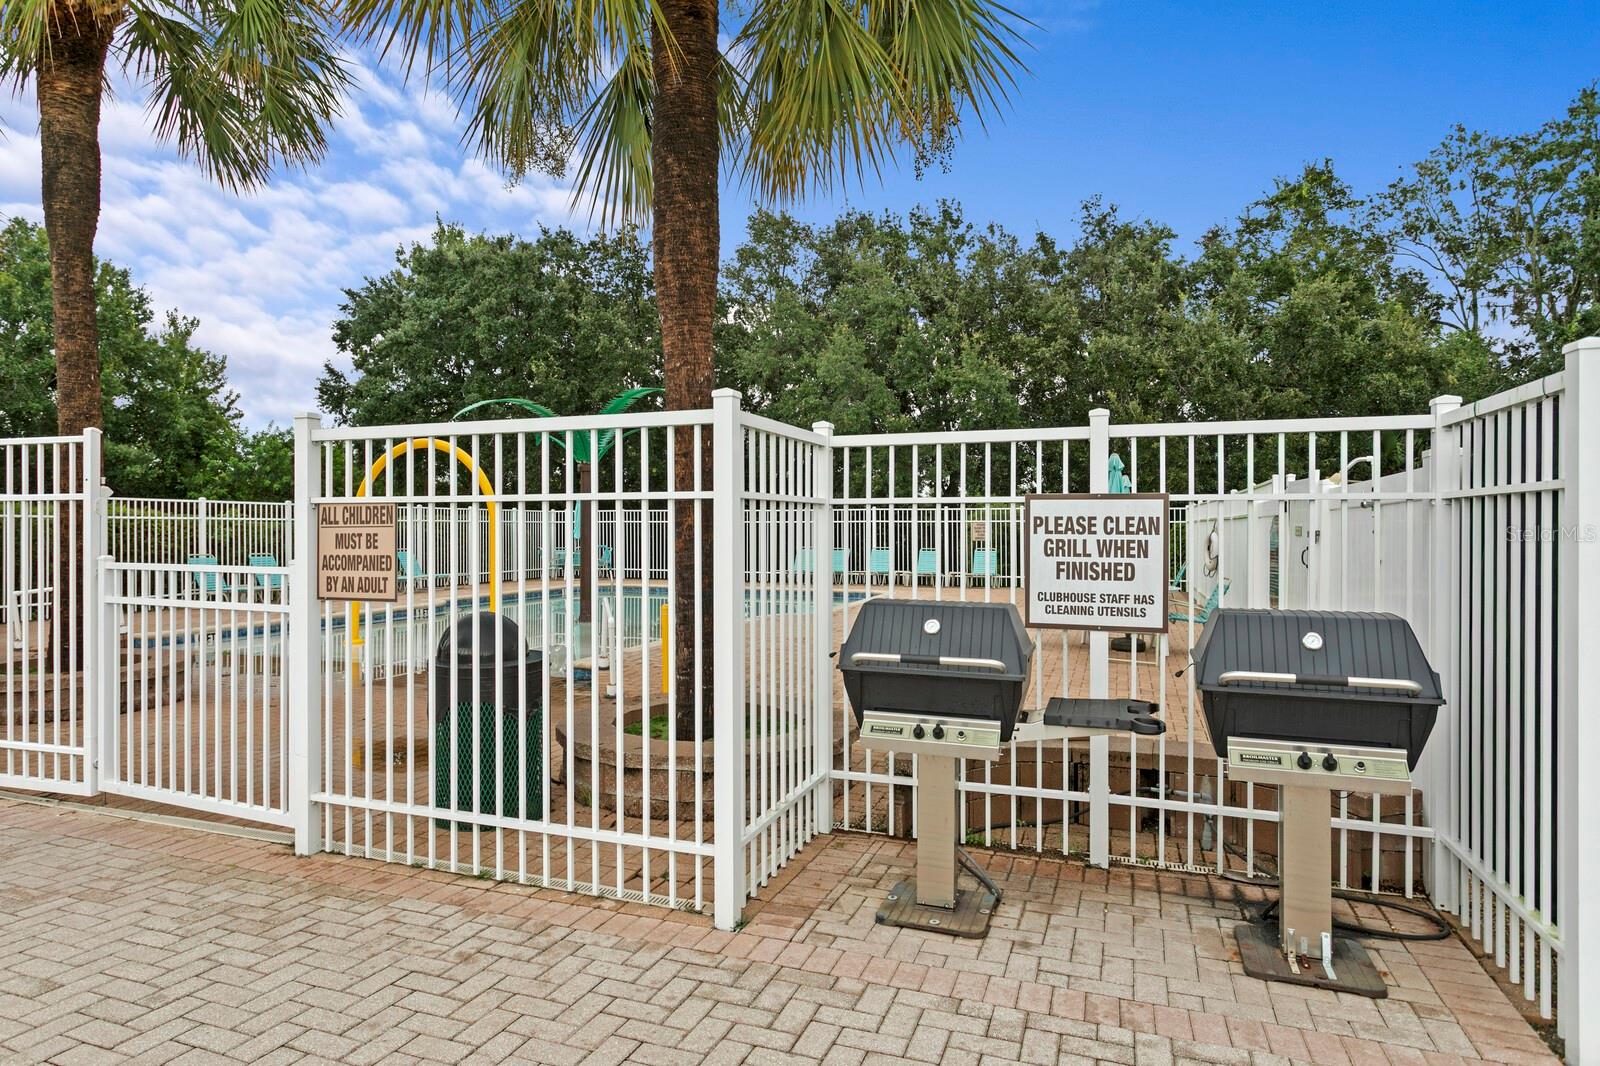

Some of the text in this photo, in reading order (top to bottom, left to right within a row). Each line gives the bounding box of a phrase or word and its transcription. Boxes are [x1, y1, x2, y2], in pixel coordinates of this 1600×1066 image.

[321, 505, 393, 525] ALL CHILDREN
[1033, 516, 1160, 535] PLEASE CLEAN
[335, 533, 378, 549] MUST BE
[1043, 539, 1149, 558] GRILL WHEN
[322, 555, 392, 571] ACCOMPANIED
[1056, 561, 1136, 581] FINISHED
[326, 576, 388, 593] BY AN ADULT
[1037, 592, 1155, 605] CLUBHOUSE STAFF HAS
[1045, 605, 1147, 618] CLEANING UTENSILS
